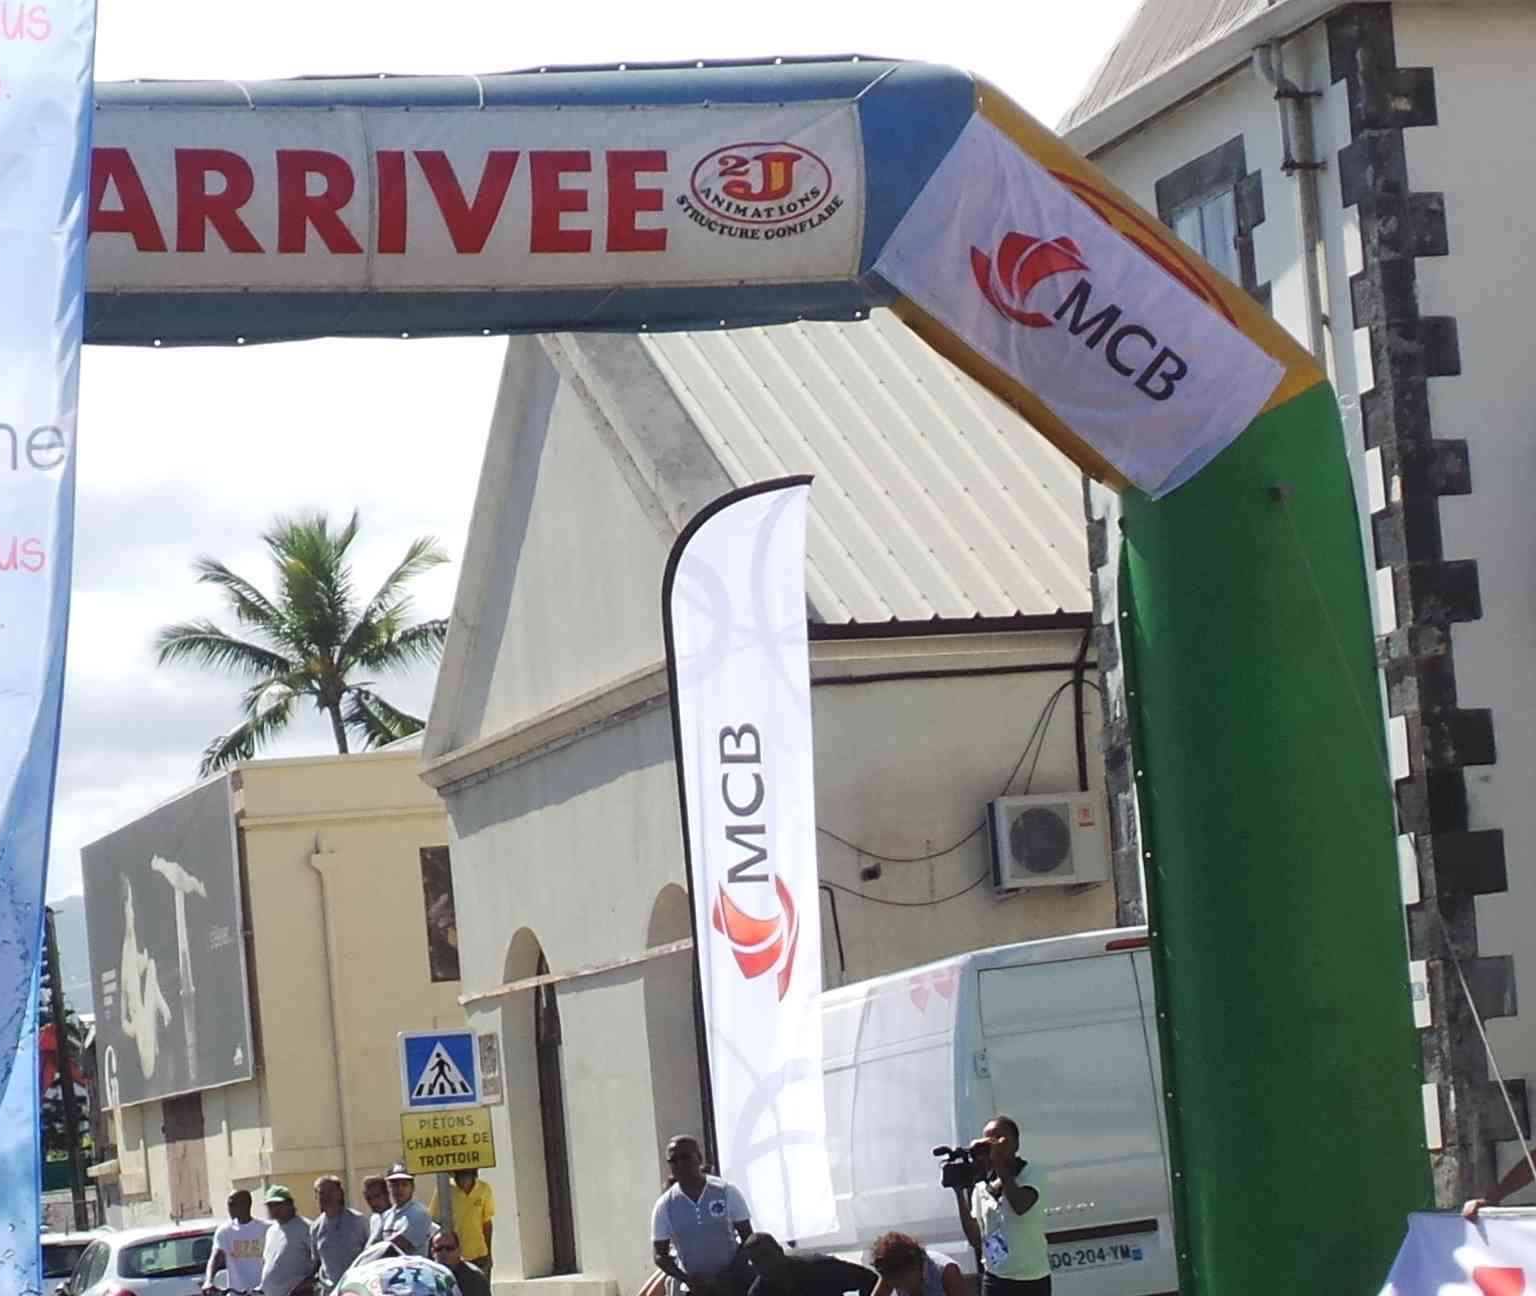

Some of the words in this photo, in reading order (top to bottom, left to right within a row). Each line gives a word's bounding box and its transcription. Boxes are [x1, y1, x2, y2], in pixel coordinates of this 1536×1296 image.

[86, 147, 669, 254] ARRIVEE
[676, 194, 761, 240] STRUCTURE
[700, 185, 822, 219] ANIMATIONS
[1052, 276, 1189, 402] MCB
[719, 721, 770, 884] MCB
[406, 1133, 468, 1151] CHANGEZ
[472, 1131, 489, 1145] DE
[419, 1151, 480, 1167] TROTTOIR
